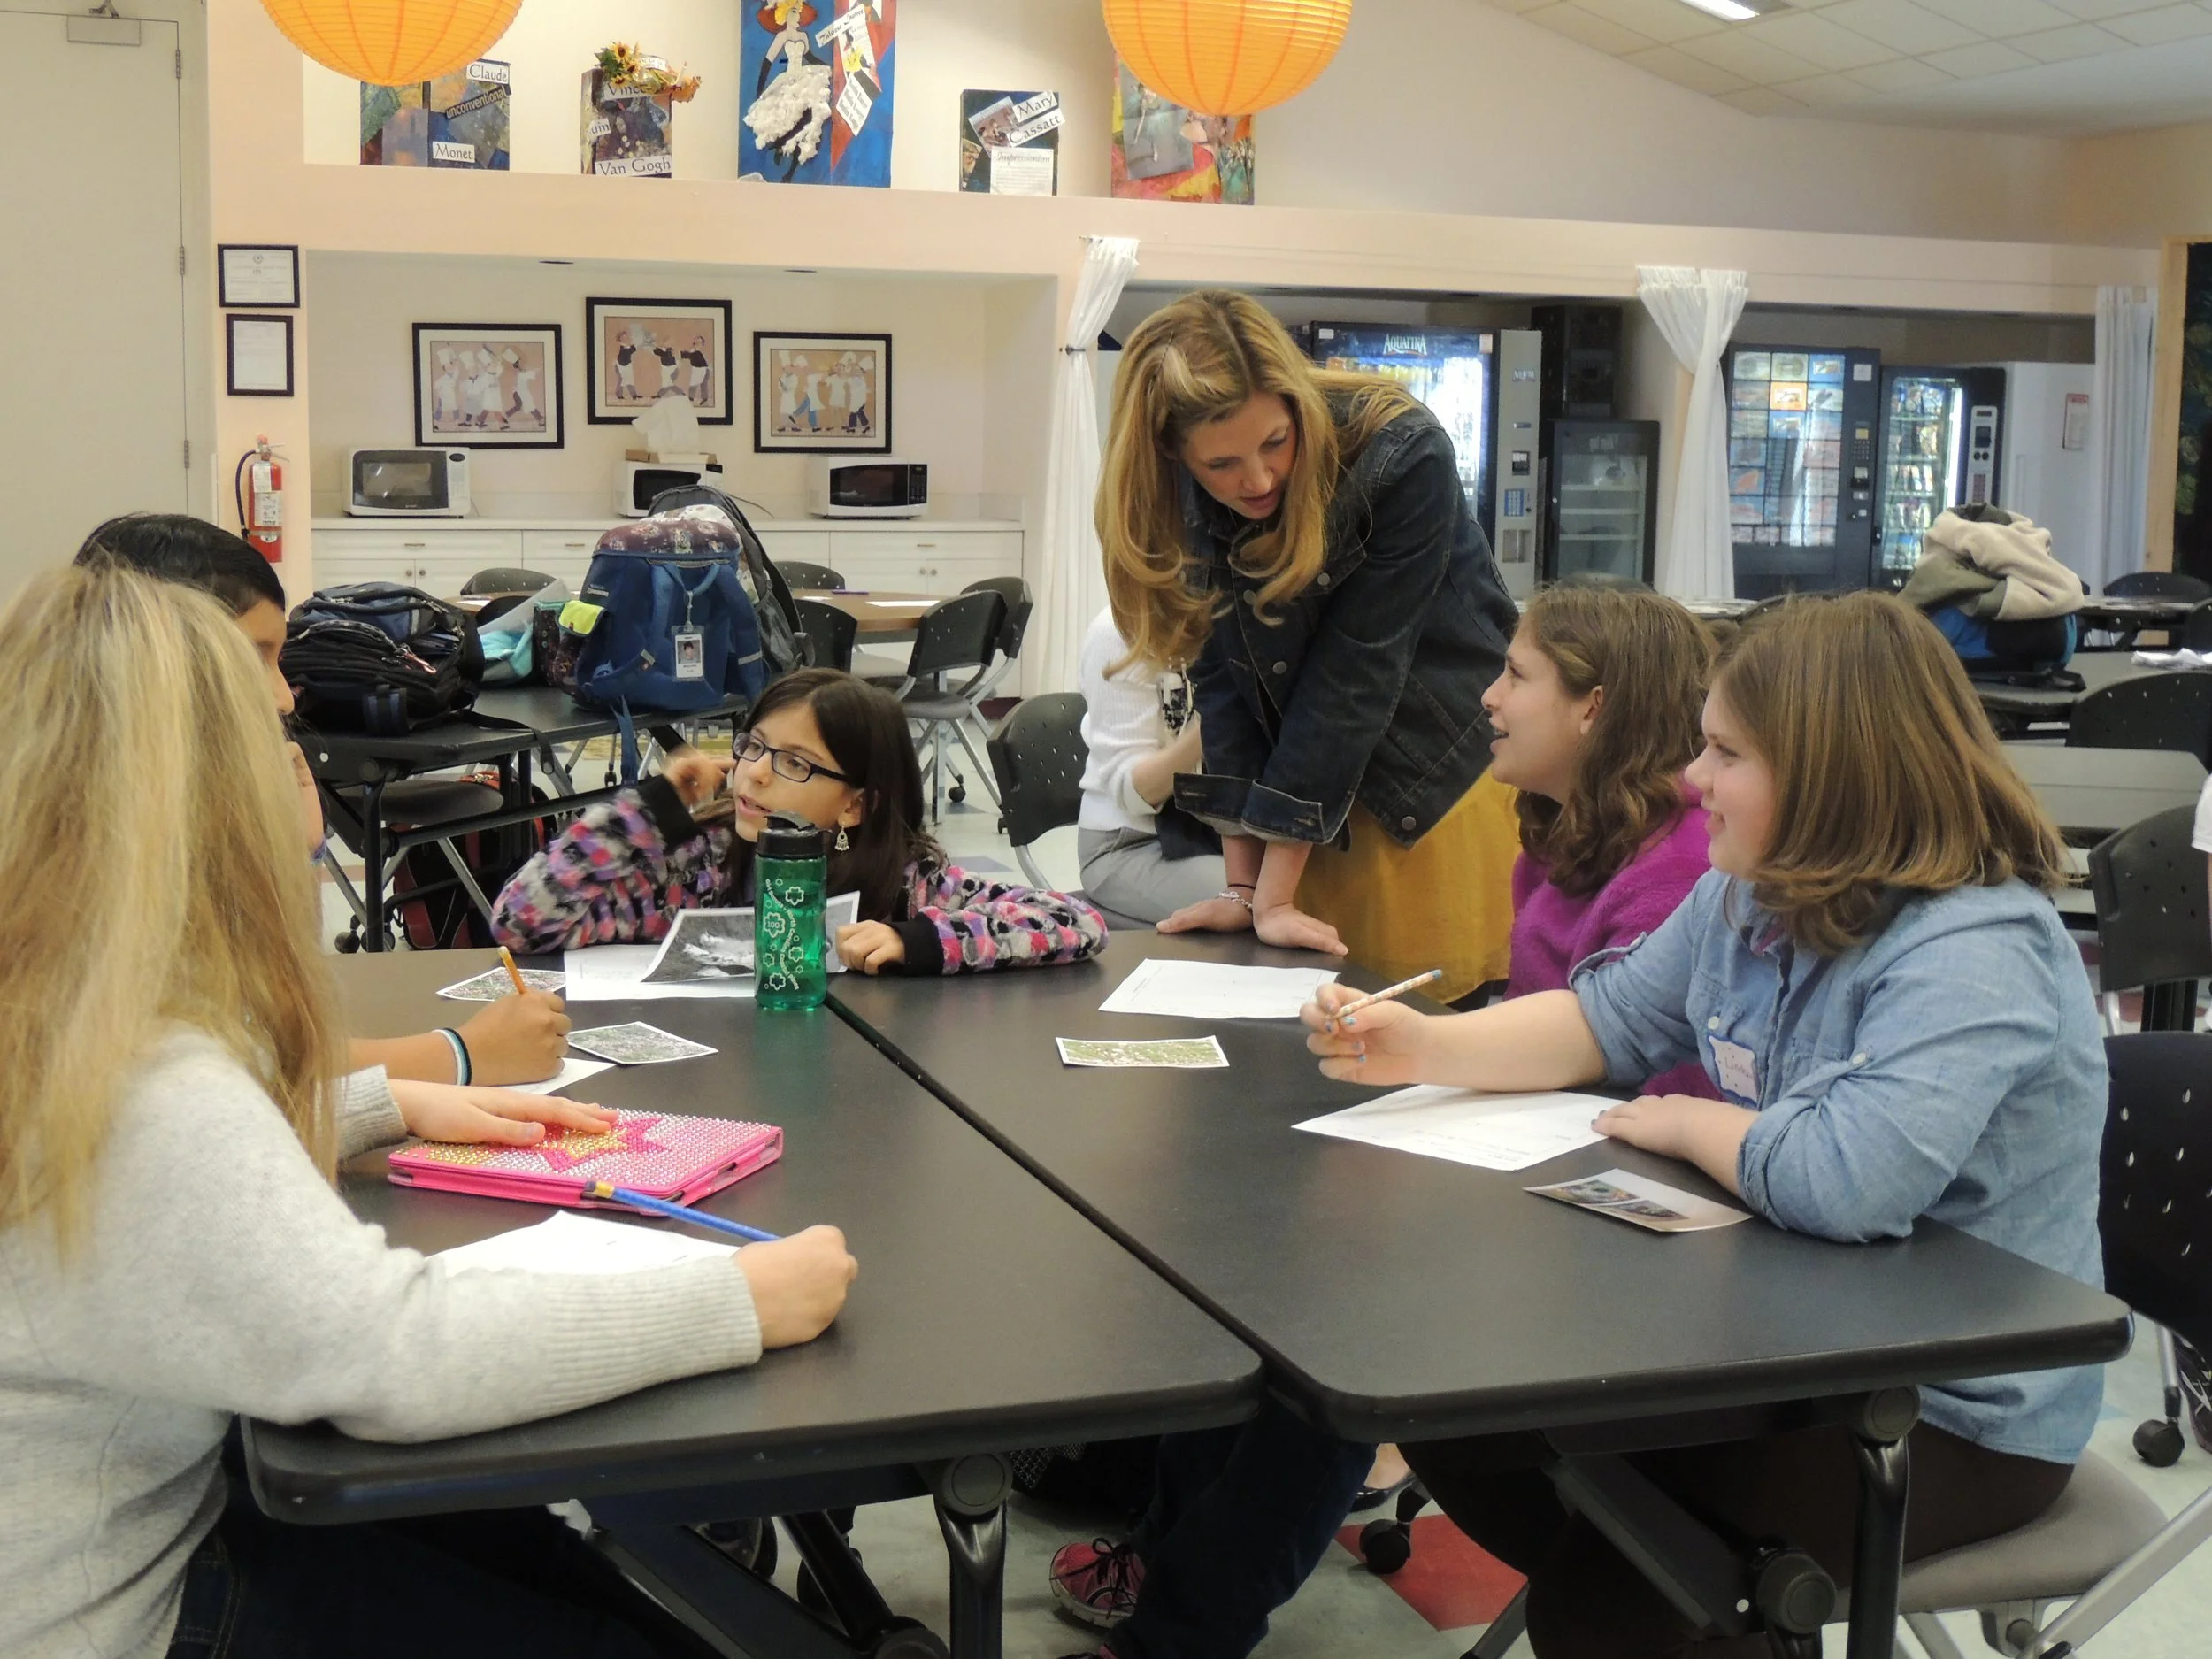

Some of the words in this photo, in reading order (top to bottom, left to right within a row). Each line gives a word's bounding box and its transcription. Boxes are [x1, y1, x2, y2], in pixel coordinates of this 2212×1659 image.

[469, 64, 507, 82] Claude
[446, 85, 508, 119] unconventional
[1017, 95, 1053, 118] Mary
[1009, 115, 1062, 143] Cassatt
[434, 143, 472, 160] Monet
[599, 162, 626, 176] Van
[631, 157, 671, 174] Gogh
[1382, 333, 1428, 356] AQUAFINA
